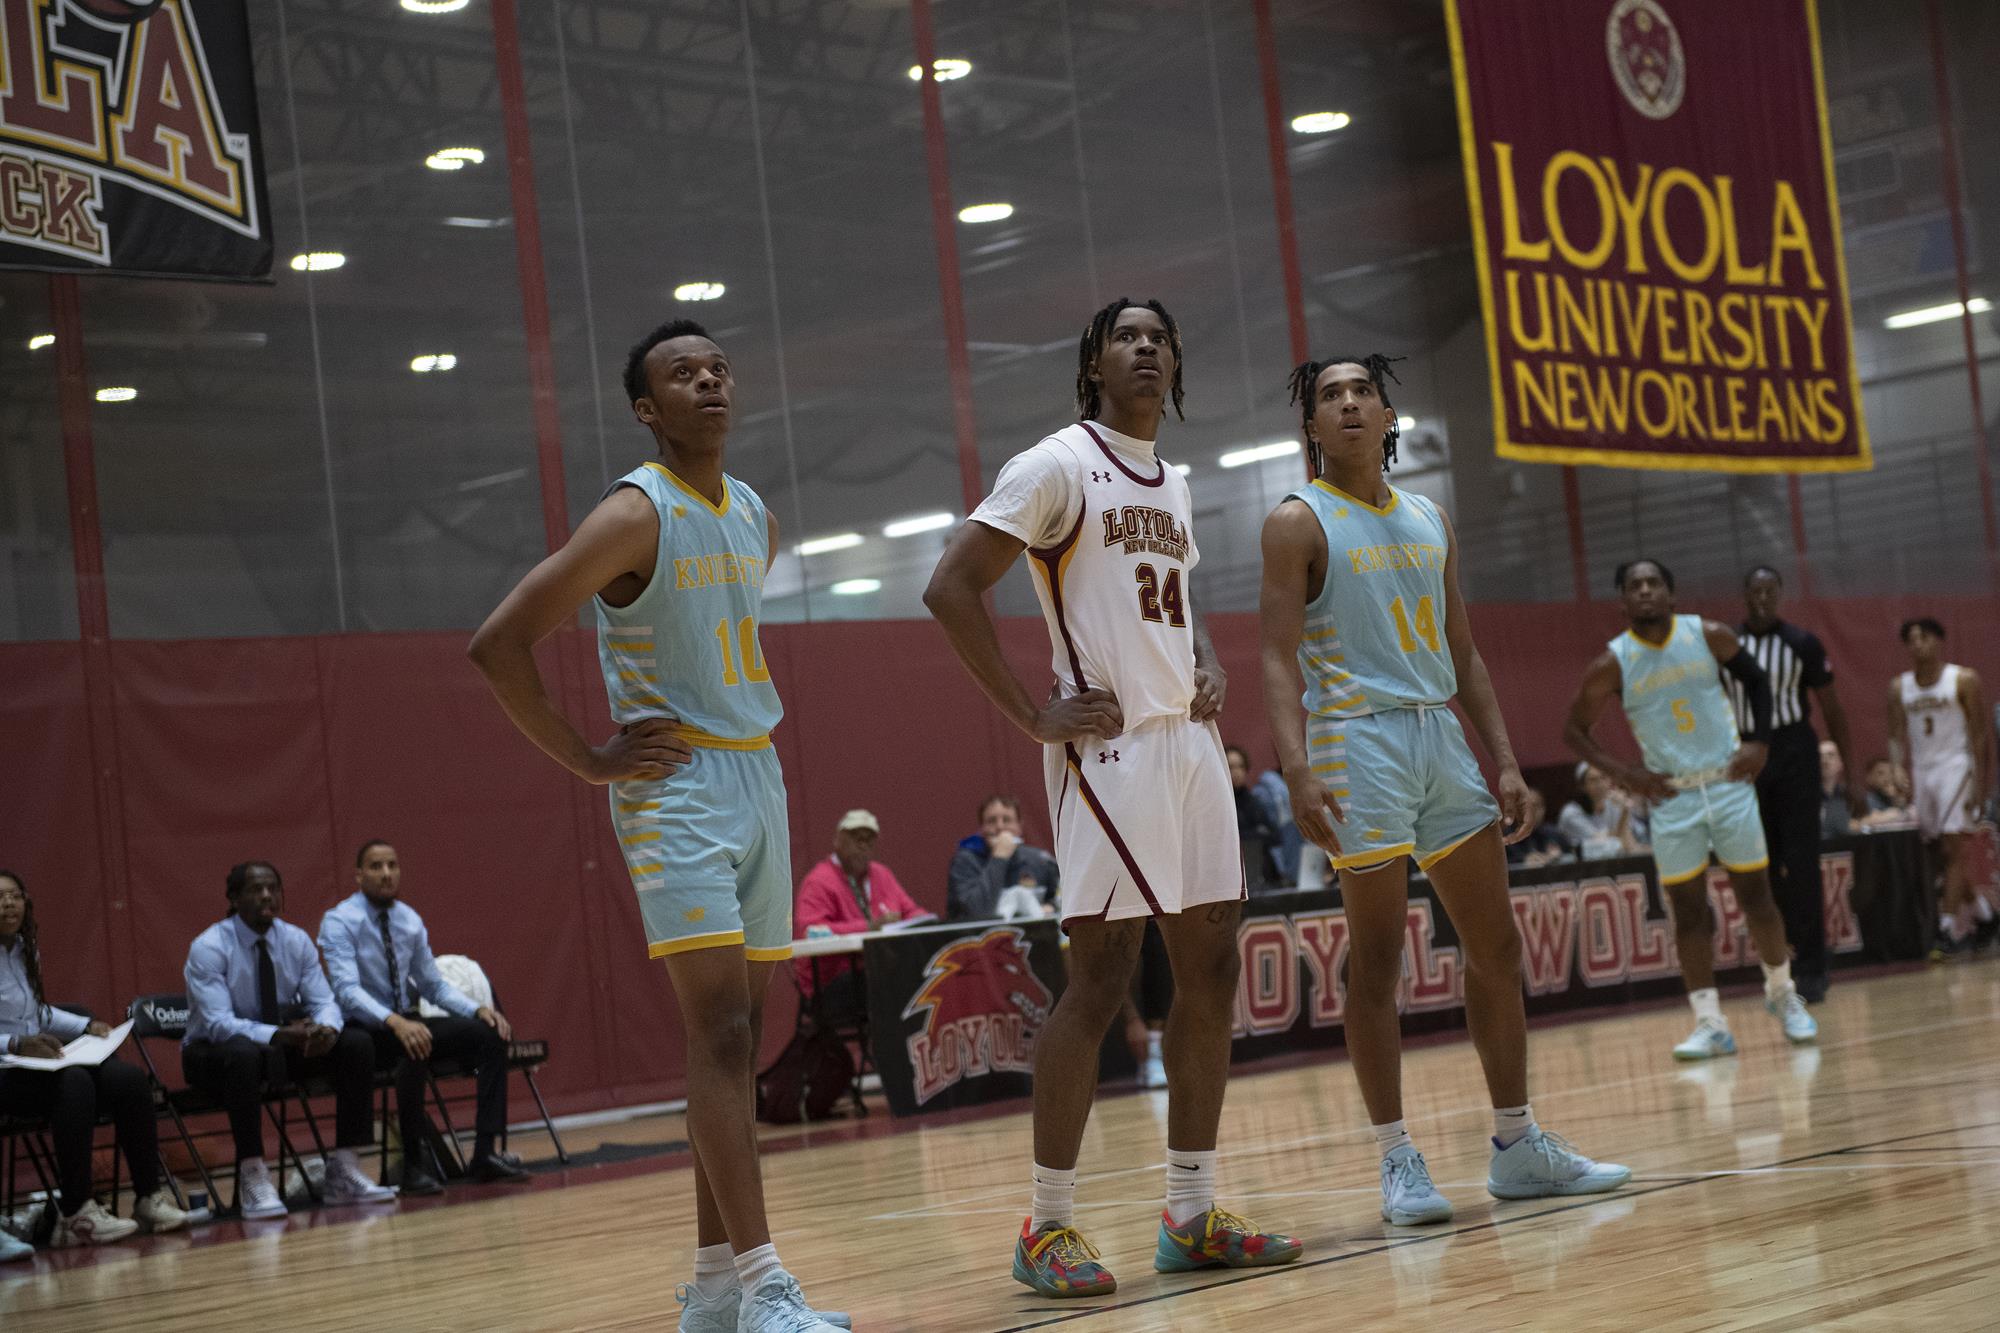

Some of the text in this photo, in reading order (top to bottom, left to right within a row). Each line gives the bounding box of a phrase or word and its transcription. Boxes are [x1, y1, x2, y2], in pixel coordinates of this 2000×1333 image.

[1492, 141, 1825, 289] LOYOLA
[1505, 269, 1829, 371] UNIVERSITY
[1103, 506, 1189, 558] LOYOLA
[1123, 539, 1146, 556] NEW
[1347, 544, 1446, 574] KNGHTS
[1135, 562, 1186, 628] 24
[1388, 593, 1442, 655] 14
[715, 615, 770, 687] 10
[1670, 698, 1697, 735] 5
[1510, 872, 1683, 997] WOL
[907, 1013, 1036, 1106] LOYOL
